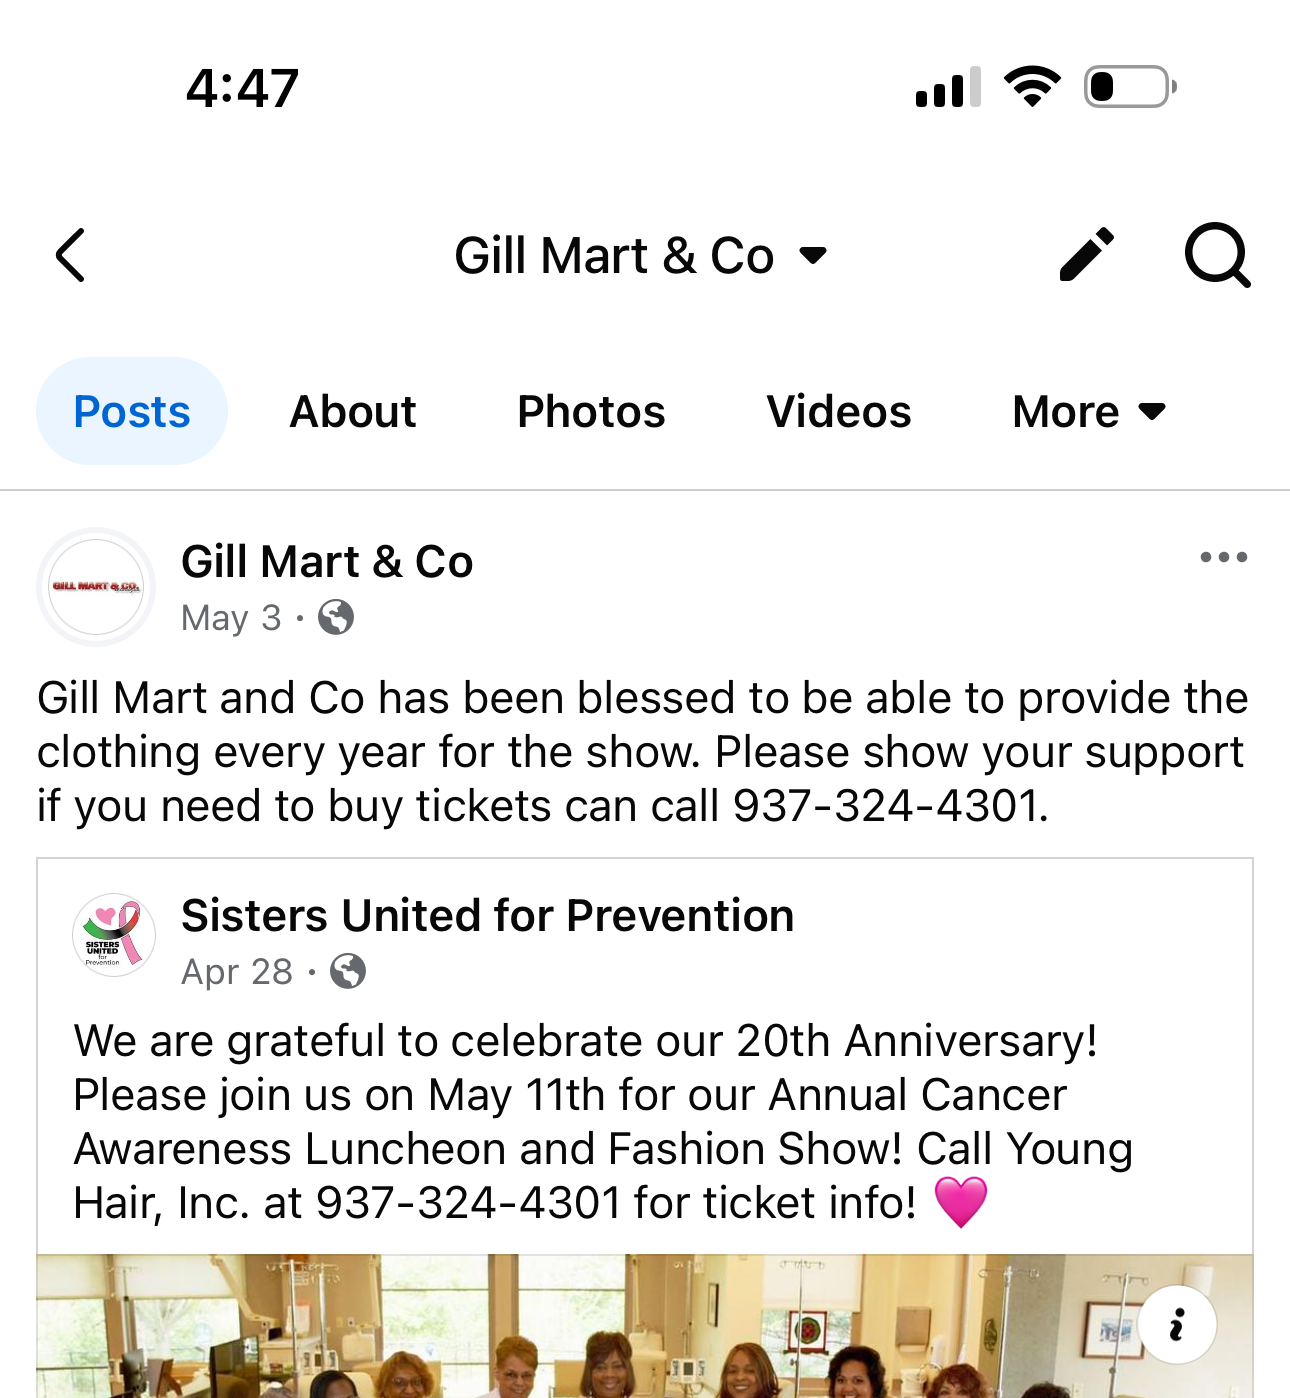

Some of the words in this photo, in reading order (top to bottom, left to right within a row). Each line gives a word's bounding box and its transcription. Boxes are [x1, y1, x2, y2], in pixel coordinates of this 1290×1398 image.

[186, 68, 299, 108] 4:47
[455, 233, 525, 275] Gill
[542, 236, 648, 275] Mart
[663, 235, 698, 275] &
[711, 235, 774, 275] Co
[75, 394, 191, 429] Posts
[288, 392, 417, 429] About
[519, 392, 666, 429] Photos
[765, 391, 912, 429] Videos
[1014, 394, 1120, 429] More
[181, 541, 246, 579] Gill
[262, 544, 360, 579] Mart
[372, 543, 404, 579] &
[415, 543, 474, 579] Co
[52, 581, 77, 591] GILL
[78, 581, 109, 591] MART
[182, 603, 249, 638] May
[261, 603, 281, 632] 3
[38, 678, 98, 715] Gill
[115, 680, 207, 715] Mart
[220, 679, 294, 715] and
[310, 679, 364, 715] Co
[379, 679, 449, 715] has
[464, 679, 563, 715] been
[578, 679, 734, 715] blessed
[748, 682, 789, 715] to
[803, 679, 853, 715] be
[866, 679, 952, 715] able
[964, 682, 1004, 715] to
[1019, 678, 1171, 722] provide
[1183, 679, 1249, 715] the
[37, 732, 199, 777] clothing
[214, 742, 326, 777] every
[337, 742, 426, 777] year
[438, 732, 495, 769] for
[507, 733, 573, 769] the
[586, 733, 700, 769] show.
[717, 733, 850, 769] Please
[863, 733, 969, 769] show
[981, 742, 1073, 777] your
[1085, 736, 1244, 776] support
[38, 786, 62, 822] if
[73, 796, 146, 831] you
[162, 787, 260, 823] need
[274, 790, 314, 823] to
[329, 787, 404, 831] buy
[415, 786, 551, 823] tickets
[565, 796, 636, 823] can
[651, 787, 718, 823] call
[734, 787, 1048, 823] 937-324-4301.
[181, 895, 328, 933] Sisters
[343, 895, 480, 933] United
[493, 896, 555, 933] for
[568, 895, 794, 933] Prevention
[180, 957, 240, 992] Apr
[252, 957, 293, 986] 28
[73, 1023, 137, 1058] We
[150, 1031, 214, 1058] are
[227, 1021, 384, 1066] grateful
[397, 1025, 438, 1058] to
[451, 1022, 643, 1058] celebrate
[656, 1031, 724, 1058] our
[737, 1022, 829, 1058] 20th
[843, 1021, 1096, 1066] Anniversary!
[75, 1076, 207, 1112] Please
[217, 1075, 290, 1119] join
[305, 1085, 351, 1112] us
[365, 1085, 413, 1112] on
[430, 1077, 513, 1120] May
[527, 1076, 604, 1111] 11th
[618, 1075, 676, 1112] for
[688, 1085, 756, 1112] our
[767, 1076, 906, 1112] Annual
[922, 1076, 1068, 1112] Cancer
[72, 1131, 291, 1166] Awareness
[307, 1130, 505, 1166] Luncheon
[520, 1130, 594, 1166] and
[610, 1129, 764, 1166] Fashion
[778, 1130, 901, 1166] Show!
[918, 1130, 991, 1167] Call
[1006, 1131, 1132, 1174] Young
[75, 1183, 162, 1227] Hair,
[180, 1185, 249, 1220] Inc.
[264, 1187, 302, 1220] at
[317, 1184, 618, 1220] 937-324-4301
[633, 1183, 691, 1220] for
[702, 1183, 815, 1220] ticket
[830, 1183, 915, 1220] info!
